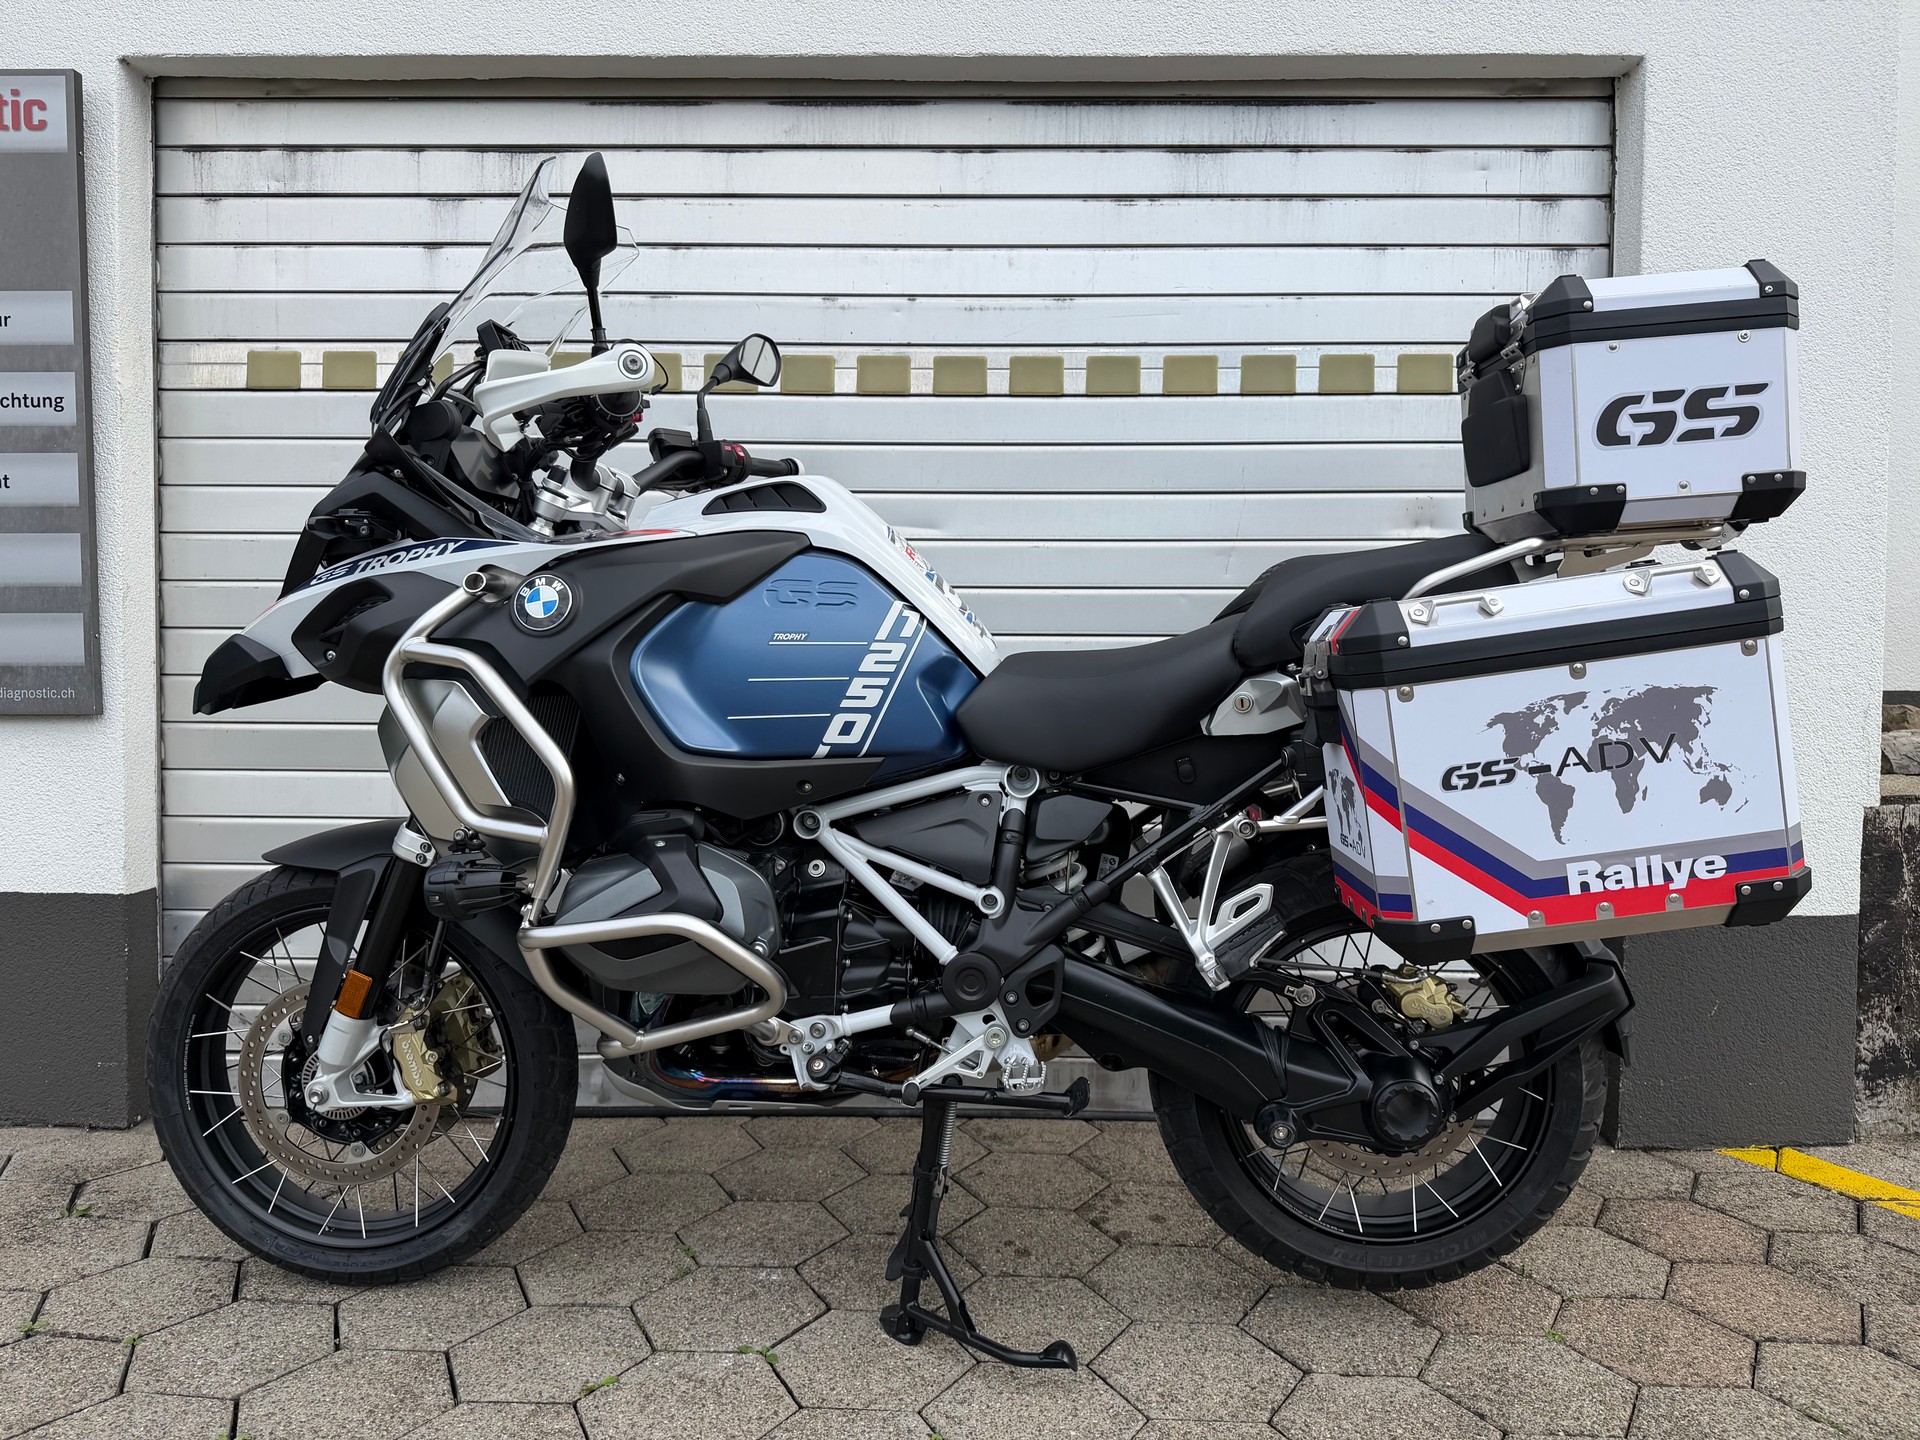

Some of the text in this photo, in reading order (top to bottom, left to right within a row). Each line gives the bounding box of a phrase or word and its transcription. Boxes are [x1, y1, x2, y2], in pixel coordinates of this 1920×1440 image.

[0, 392, 65, 412] chtung
[1595, 382, 1770, 447] GS
[309, 540, 466, 586] GS TROPHY
[519, 577, 565, 598] BMW
[763, 578, 859, 609] GS
[773, 633, 808, 641] TROPHY
[822, 608, 921, 744] 1250
[1565, 854, 1728, 896] Rallye
[402, 1040, 423, 1087] brembo
